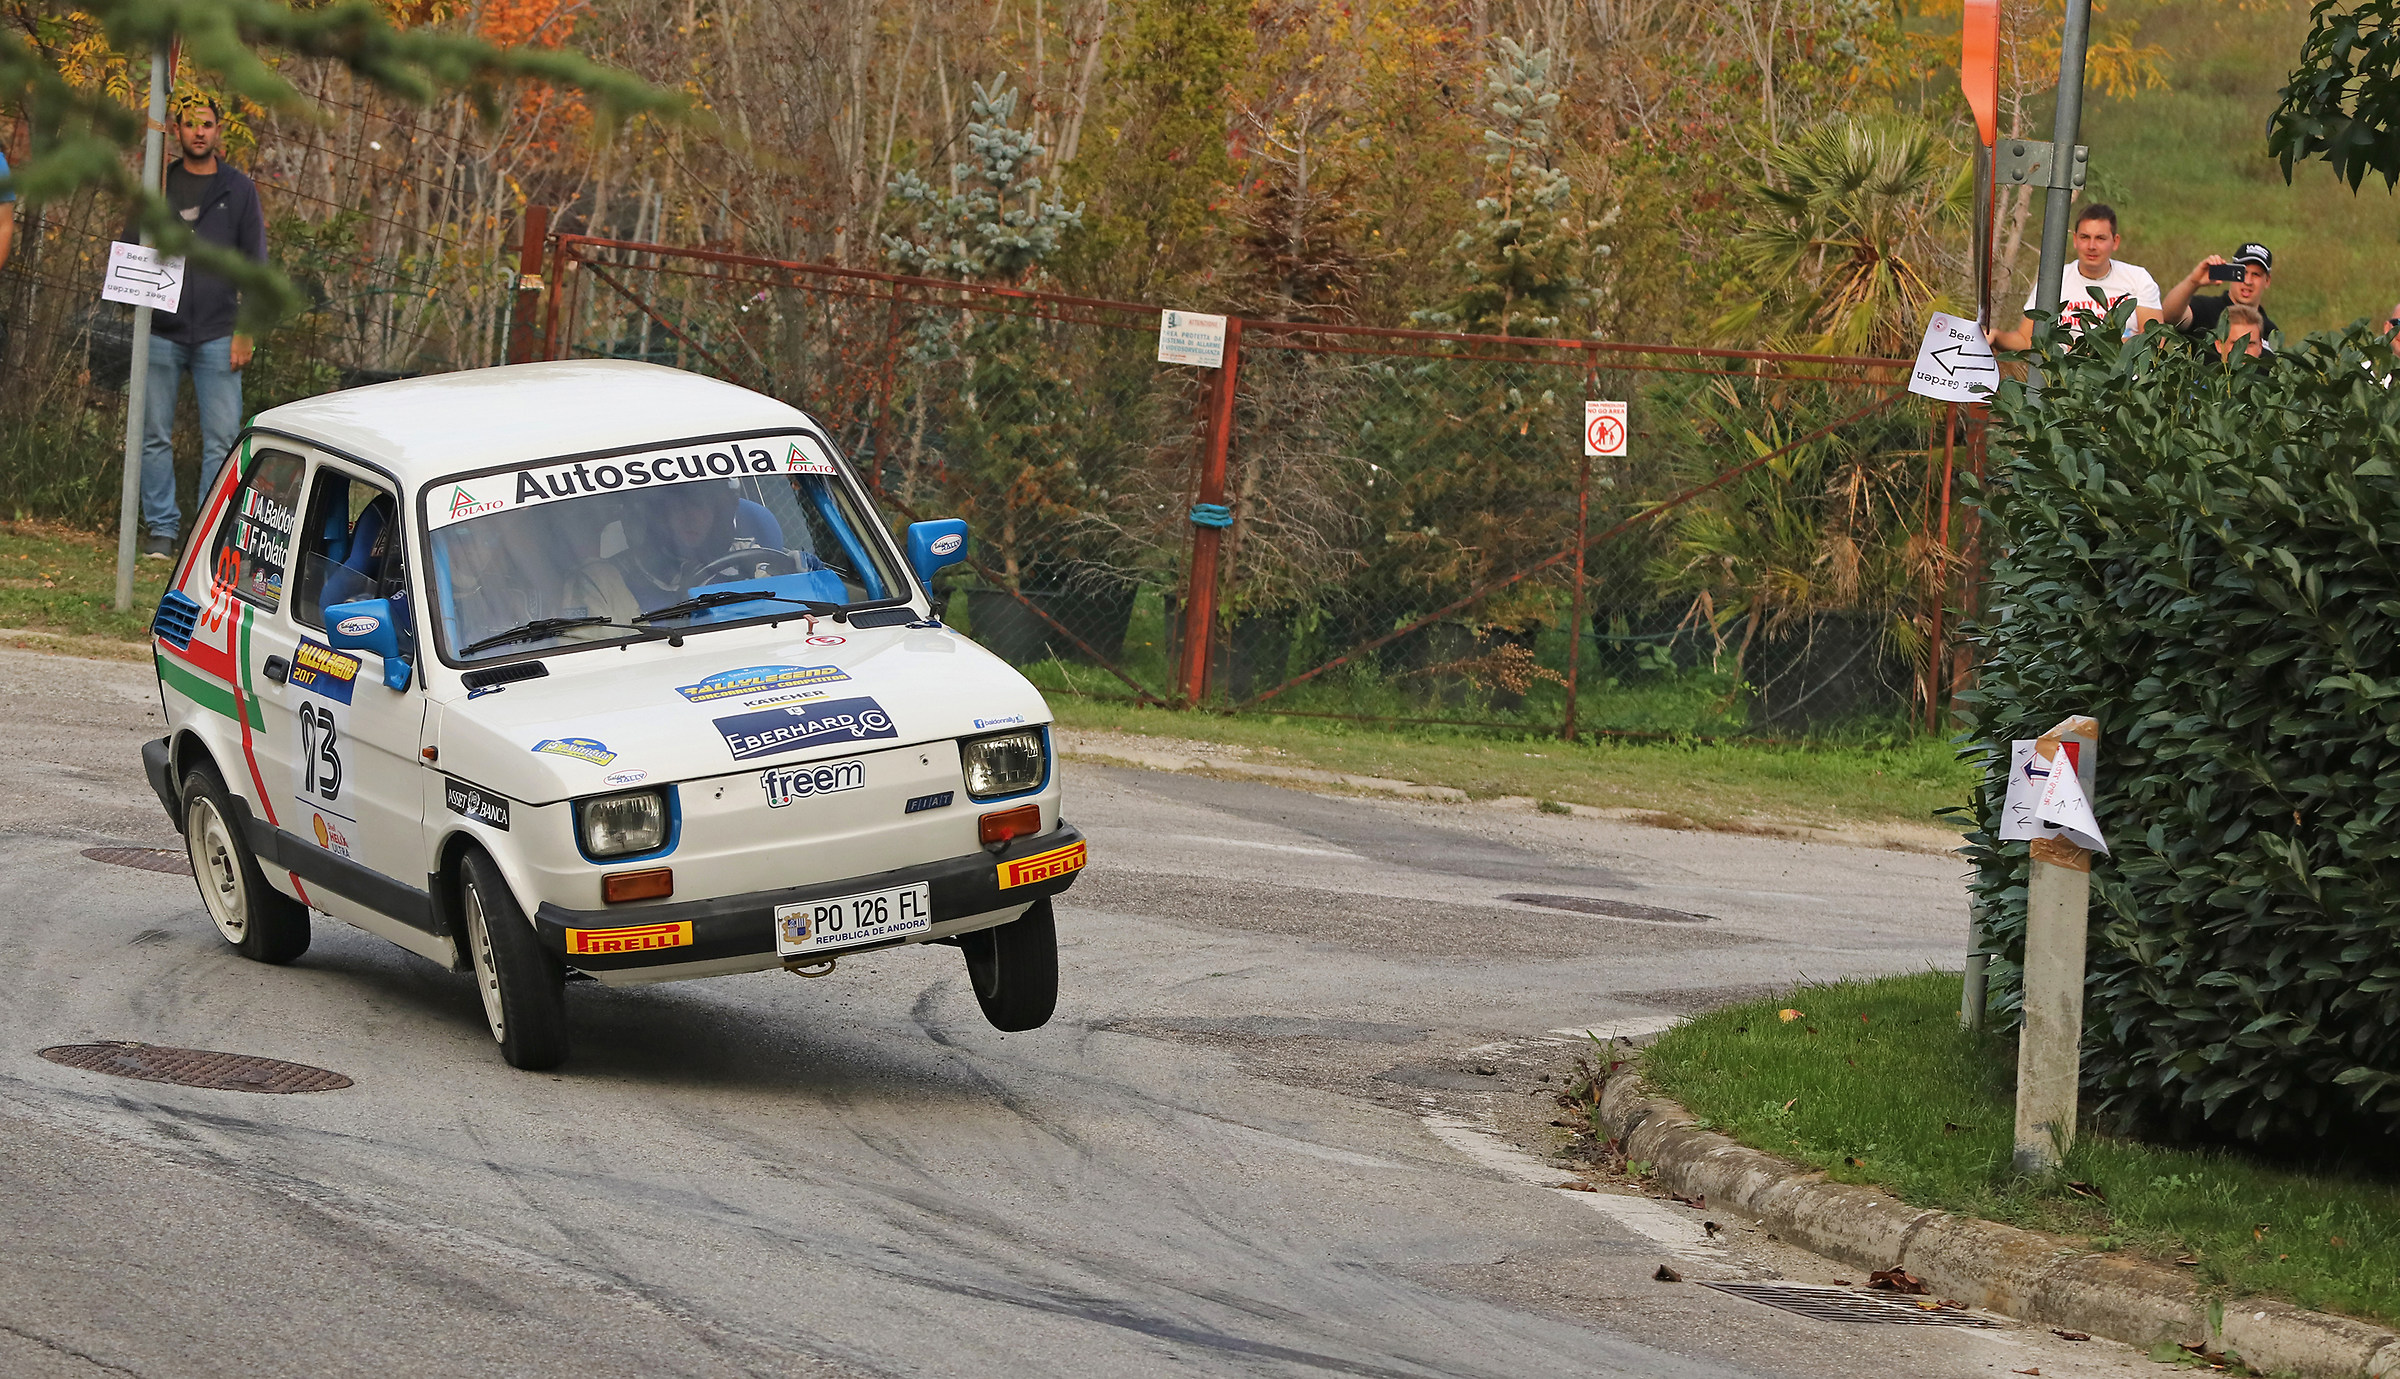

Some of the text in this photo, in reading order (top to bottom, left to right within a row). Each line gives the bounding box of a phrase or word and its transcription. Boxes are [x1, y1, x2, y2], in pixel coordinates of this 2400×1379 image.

[126, 252, 148, 263] Beer
[107, 284, 167, 302] Beer Garden
[2066, 300, 2093, 312] ARTY
[1181, 331, 1210, 340] PROTETTA
[1197, 341, 1222, 349] ALLARME
[1948, 328, 1975, 342] Beer
[1916, 371, 1960, 390] Garden
[787, 447, 835, 474] POLATO
[515, 444, 777, 504] Autoscuola
[450, 489, 504, 520] POLATO
[349, 622, 376, 633] RALLY
[297, 643, 359, 682] RALLYLEGEND
[292, 667, 317, 685] 2017
[684, 667, 839, 696] RALLYLEGEND
[690, 685, 768, 702] CONCORRENTE
[781, 674, 849, 689] COMPETITOR
[726, 714, 855, 754] EBERHARD
[616, 773, 645, 784] RALLY
[765, 761, 862, 800] freem
[448, 788, 468, 809] ASSET
[911, 795, 950, 810] FIAT
[478, 801, 508, 825] BANCA
[1008, 843, 1086, 886] PIRELLI
[852, 897, 888, 928] 126
[899, 890, 927, 920] FL
[576, 924, 681, 953] PIRELLI
[816, 929, 871, 945] REPUBLICA
[872, 927, 885, 936] DE
